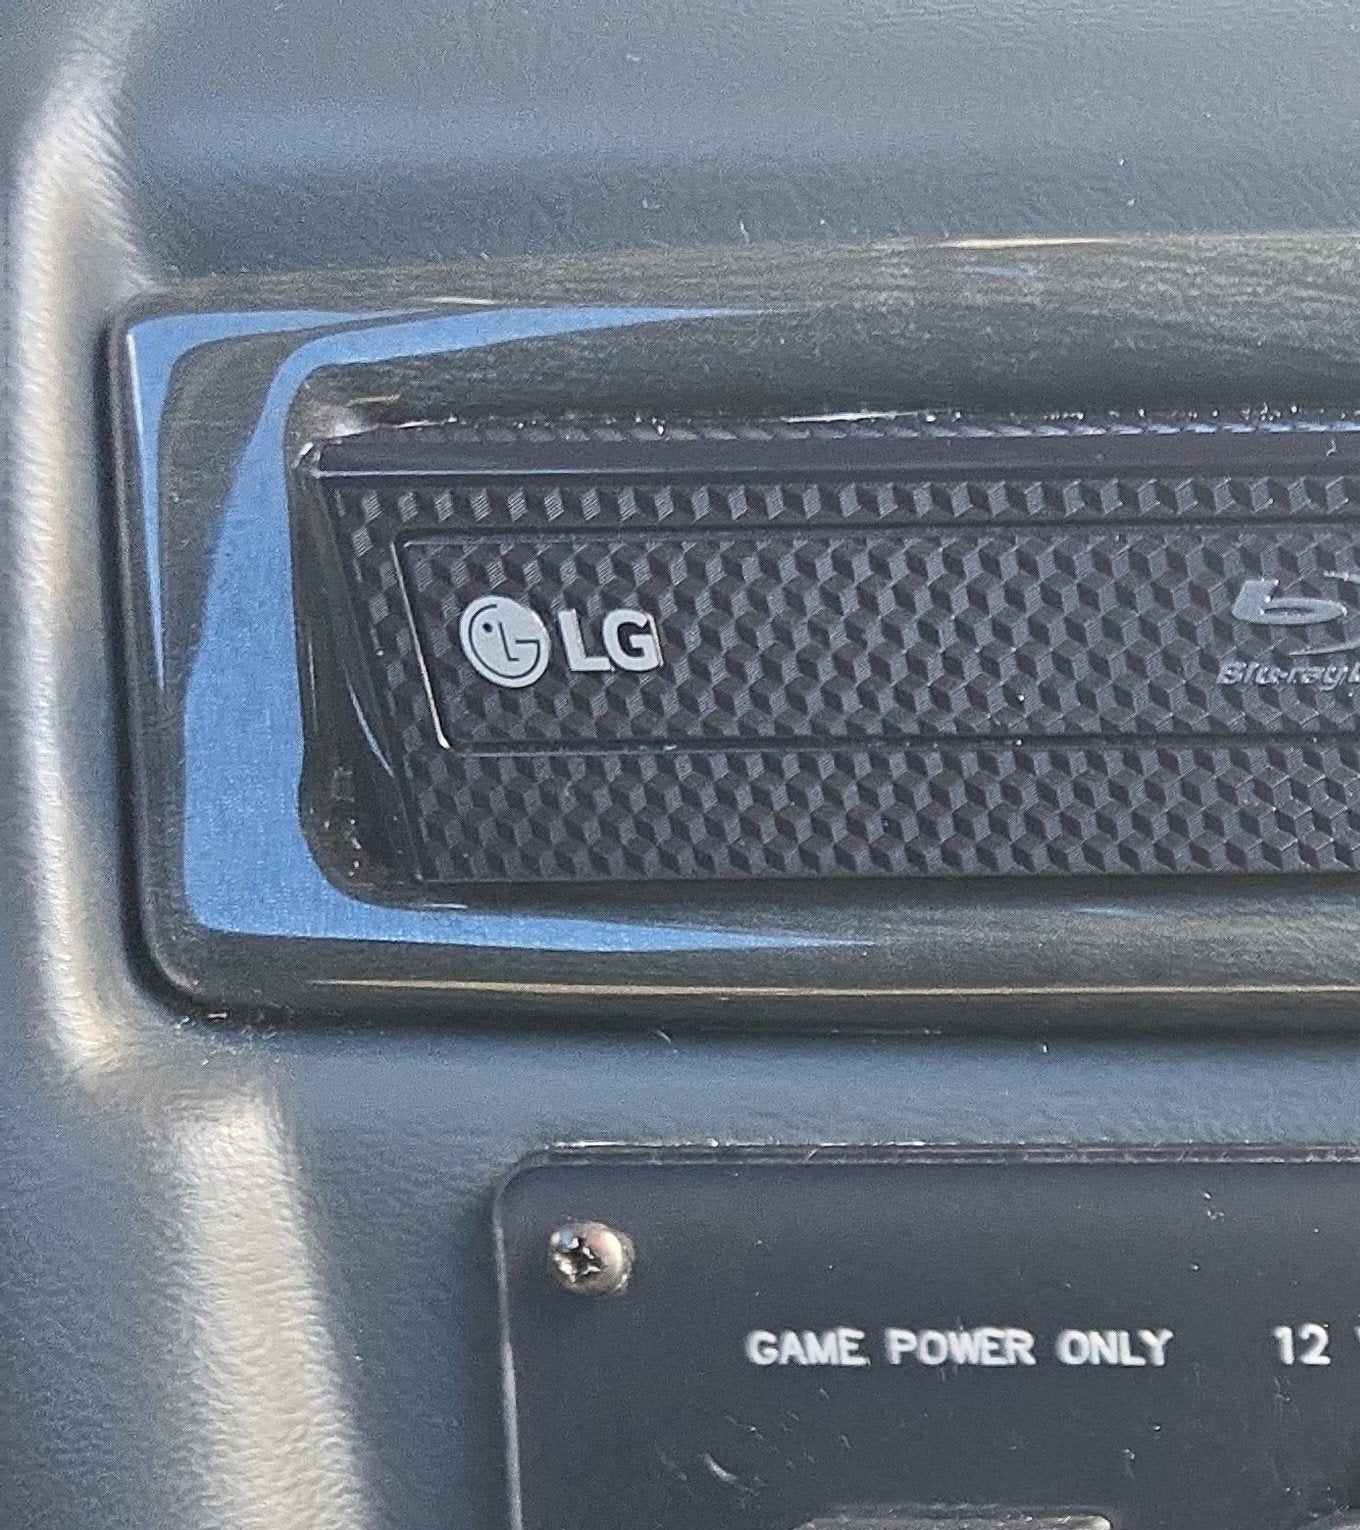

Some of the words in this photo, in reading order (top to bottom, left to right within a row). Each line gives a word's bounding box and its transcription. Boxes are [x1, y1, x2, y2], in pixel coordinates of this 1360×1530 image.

[558, 608, 664, 672] LG
[745, 1327, 869, 1365] GAME
[885, 1326, 1036, 1366] POWER
[1056, 1328, 1174, 1366] ONLY
[1274, 1323, 1331, 1365] 12
